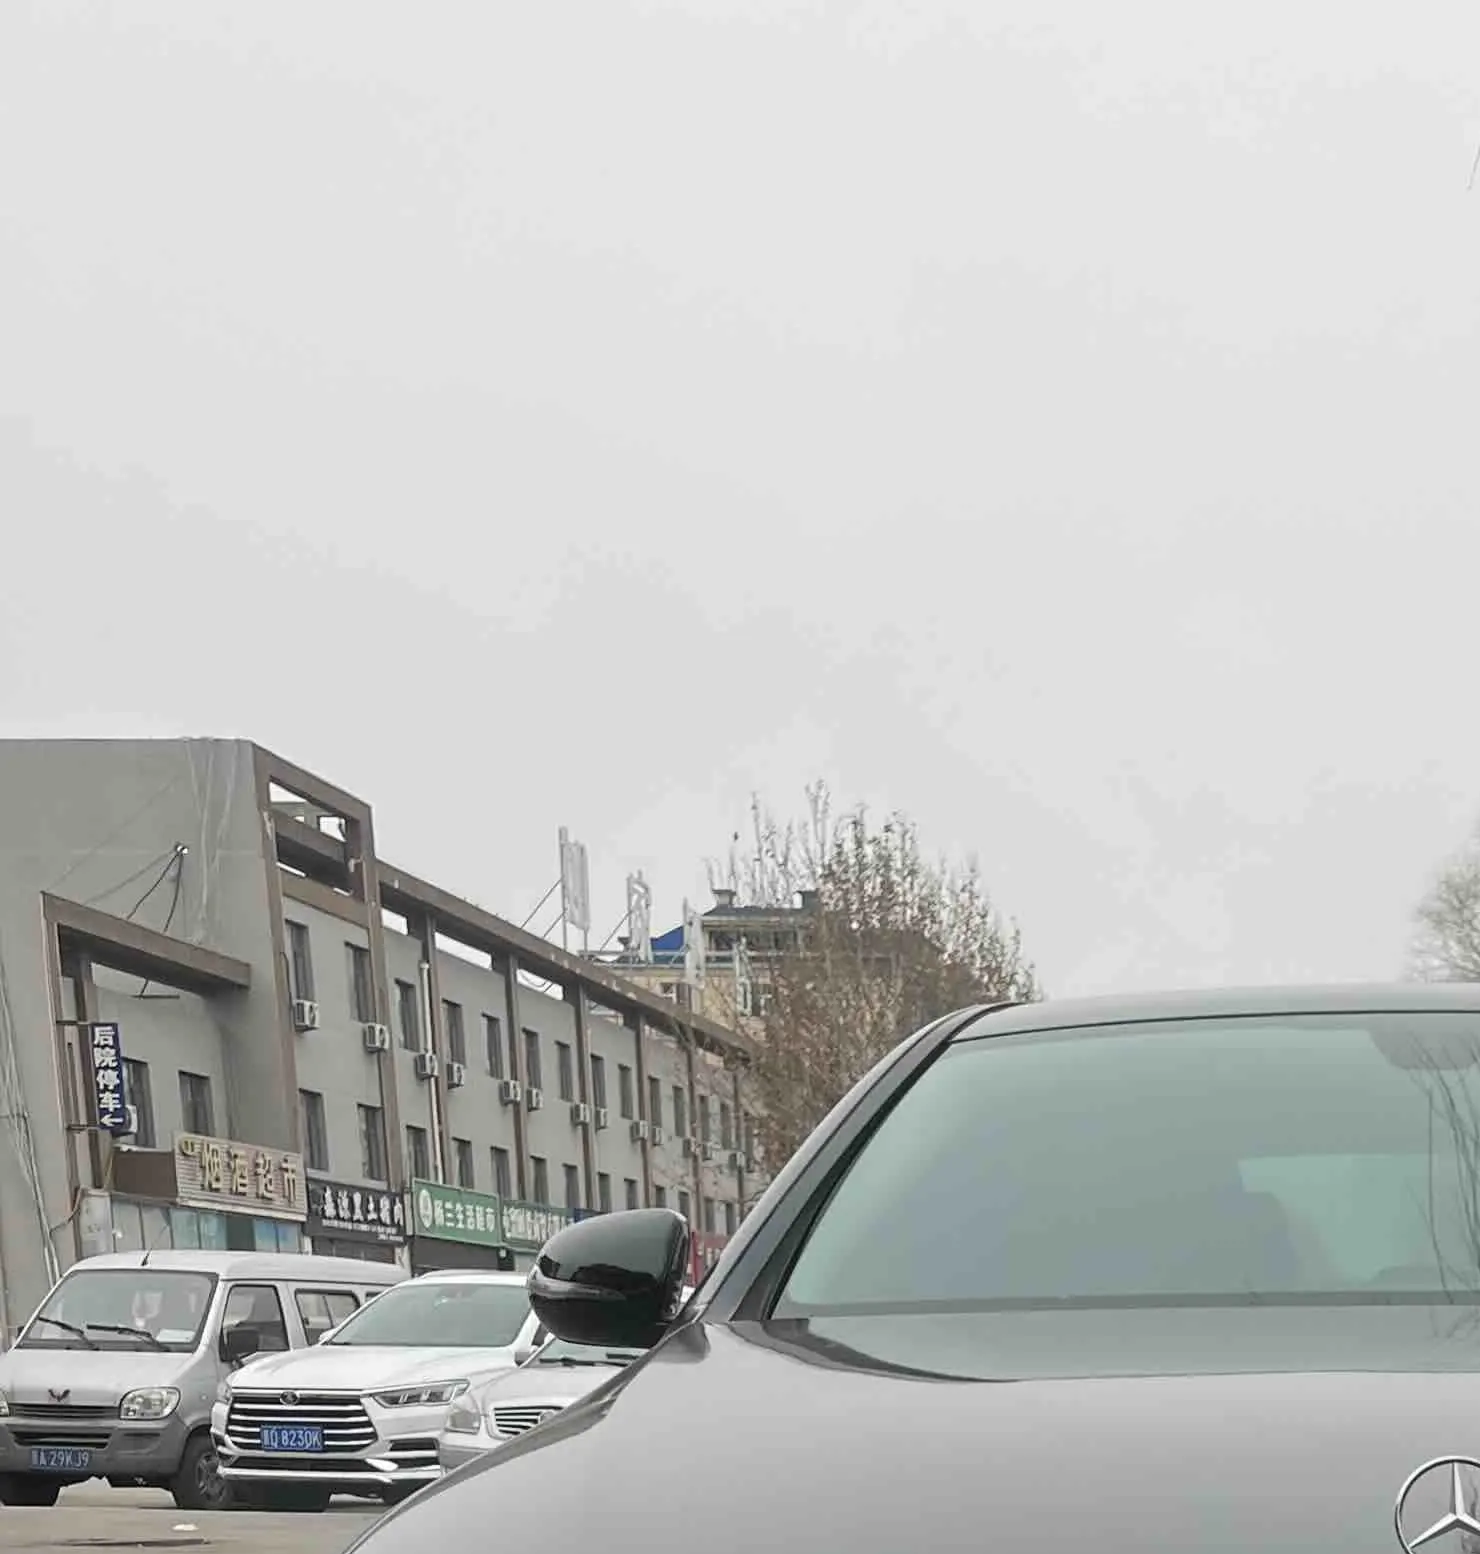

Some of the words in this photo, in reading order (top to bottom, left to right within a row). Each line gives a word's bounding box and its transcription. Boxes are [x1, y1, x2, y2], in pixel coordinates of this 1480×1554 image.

[94, 1026, 121, 1112] 后院停车
[201, 1141, 297, 1206] 烟酒超市
